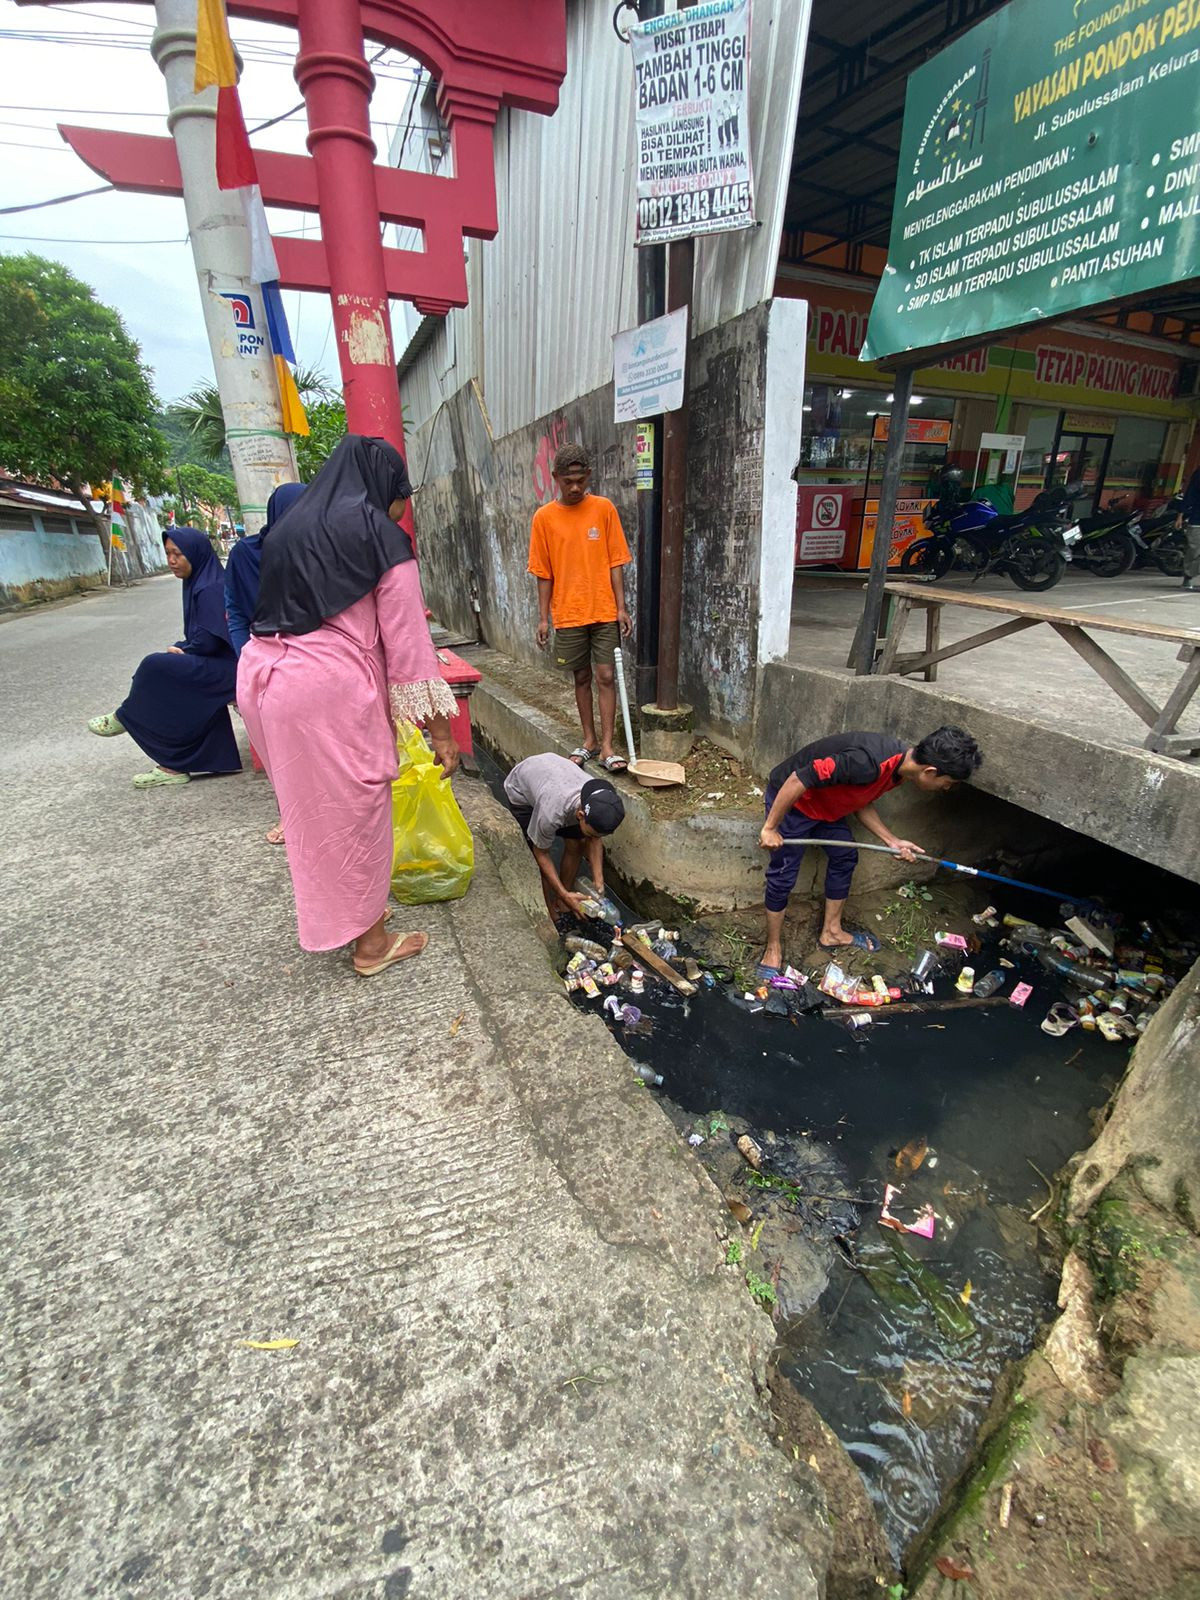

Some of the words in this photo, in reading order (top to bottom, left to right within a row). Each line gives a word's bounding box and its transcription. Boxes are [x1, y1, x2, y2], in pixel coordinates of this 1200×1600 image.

[636, 47, 692, 84] TAMBAH
[696, 35, 746, 66] TINGGI
[654, 27, 686, 52] PUSAT
[688, 18, 725, 42] TERAPI
[1054, 32, 1075, 56] THE
[640, 71, 689, 109] BADAN
[694, 64, 716, 97] 1-6
[721, 59, 743, 92] CM
[1014, 58, 1081, 124] YAYASAN
[1082, 14, 1160, 87] PONDOK
[1034, 122, 1047, 140] Jl.
[1051, 75, 1144, 131] Subulussalam
[1147, 48, 1200, 84] Kelura
[641, 122, 670, 139] HASILNYA
[671, 116, 704, 132] LANGSUNG
[918, 65, 976, 155] SUBULUSSALAM
[641, 136, 663, 151] BISA
[667, 129, 705, 146] DILIHAT
[642, 152, 653, 164] DI
[657, 143, 705, 162] TEMPAT
[640, 160, 697, 181] MENYEMBUHKAN
[700, 157, 718, 175] BUTA
[903, 180, 1002, 240] MENYELENGGARAKAN
[1003, 146, 1070, 193] PENDIDIKAN
[640, 196, 673, 229] 0812
[676, 190, 710, 224] 1343
[713, 182, 750, 216] 4445
[919, 248, 932, 266] TK
[932, 233, 963, 260] ISLAM
[965, 211, 1014, 246] TERPADU
[1016, 164, 1119, 225] SUBULUSSALAM
[907, 293, 930, 312] SMP
[930, 281, 963, 305] ISLAM
[964, 262, 1015, 294] TERPADU
[1016, 221, 1120, 275] SUBULUSSALAM
[914, 272, 928, 290] SD
[929, 259, 960, 285] ISLAM
[962, 238, 1010, 272] TERPADU
[1012, 194, 1115, 251] SUBULUSSALAM
[1061, 257, 1100, 286] PANTI
[1100, 236, 1165, 274] ASUHAN
[1035, 347, 1085, 386] TETAP
[1085, 356, 1138, 396] PALING
[1138, 365, 1179, 400] MURA
